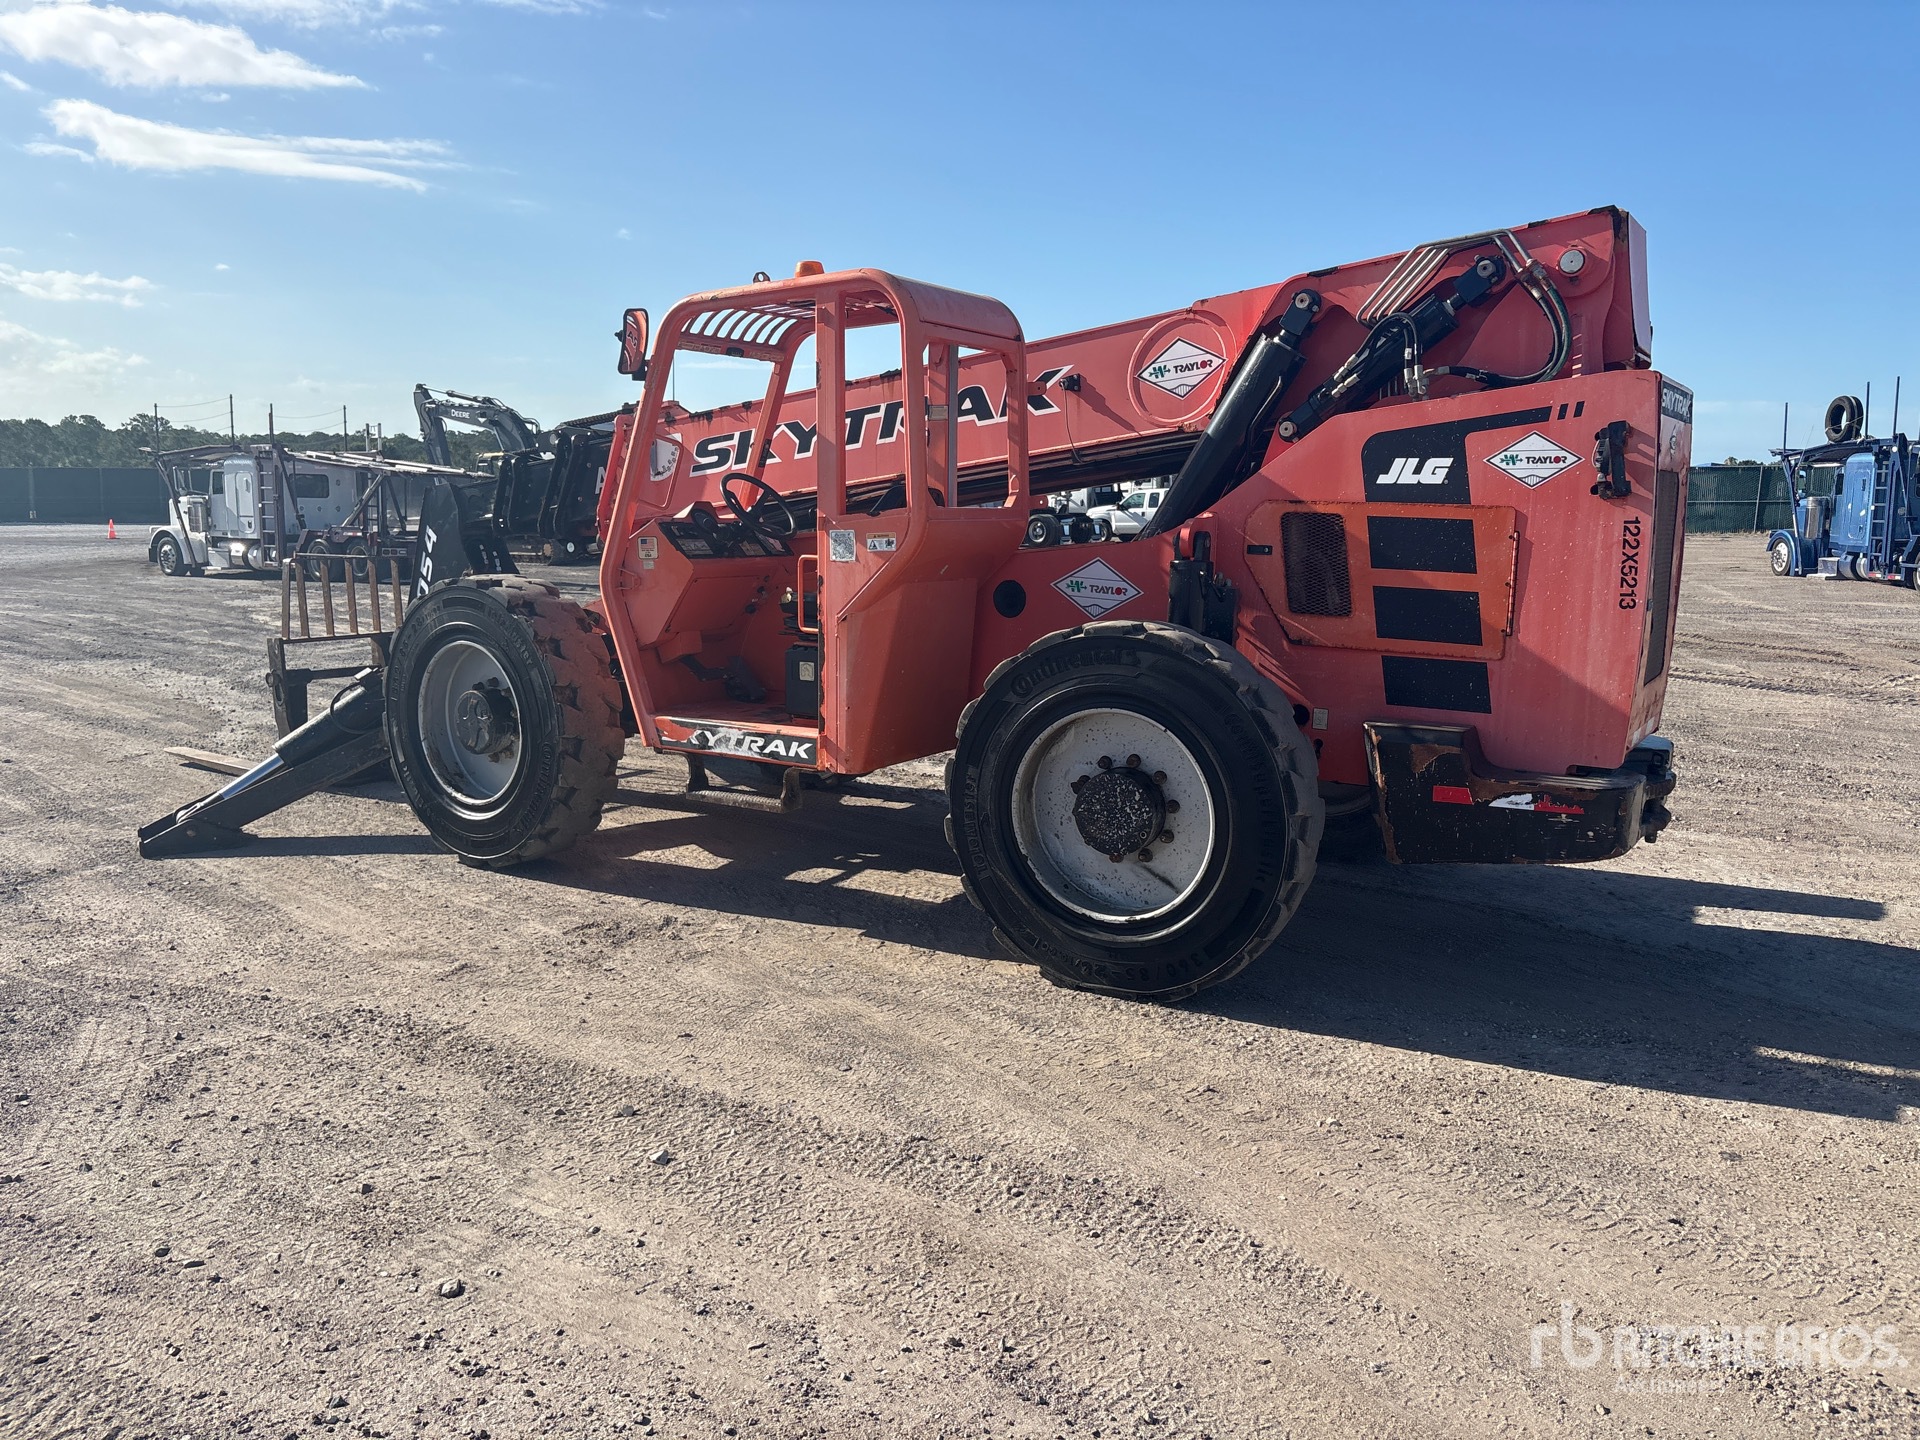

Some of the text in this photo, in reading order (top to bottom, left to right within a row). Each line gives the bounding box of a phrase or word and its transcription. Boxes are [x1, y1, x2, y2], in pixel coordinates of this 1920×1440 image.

[1173, 360, 1213, 374] TRAYLOR
[1662, 388, 1692, 417] SKYTRAK
[451, 409, 470, 419] DEERE
[1525, 455, 1567, 465] TRAYLOR
[1376, 457, 1454, 485] JLG
[1619, 516, 1641, 610] 122X5213
[1089, 584, 1128, 596] TRAYLOR
[662, 729, 813, 759] KYTRAK
